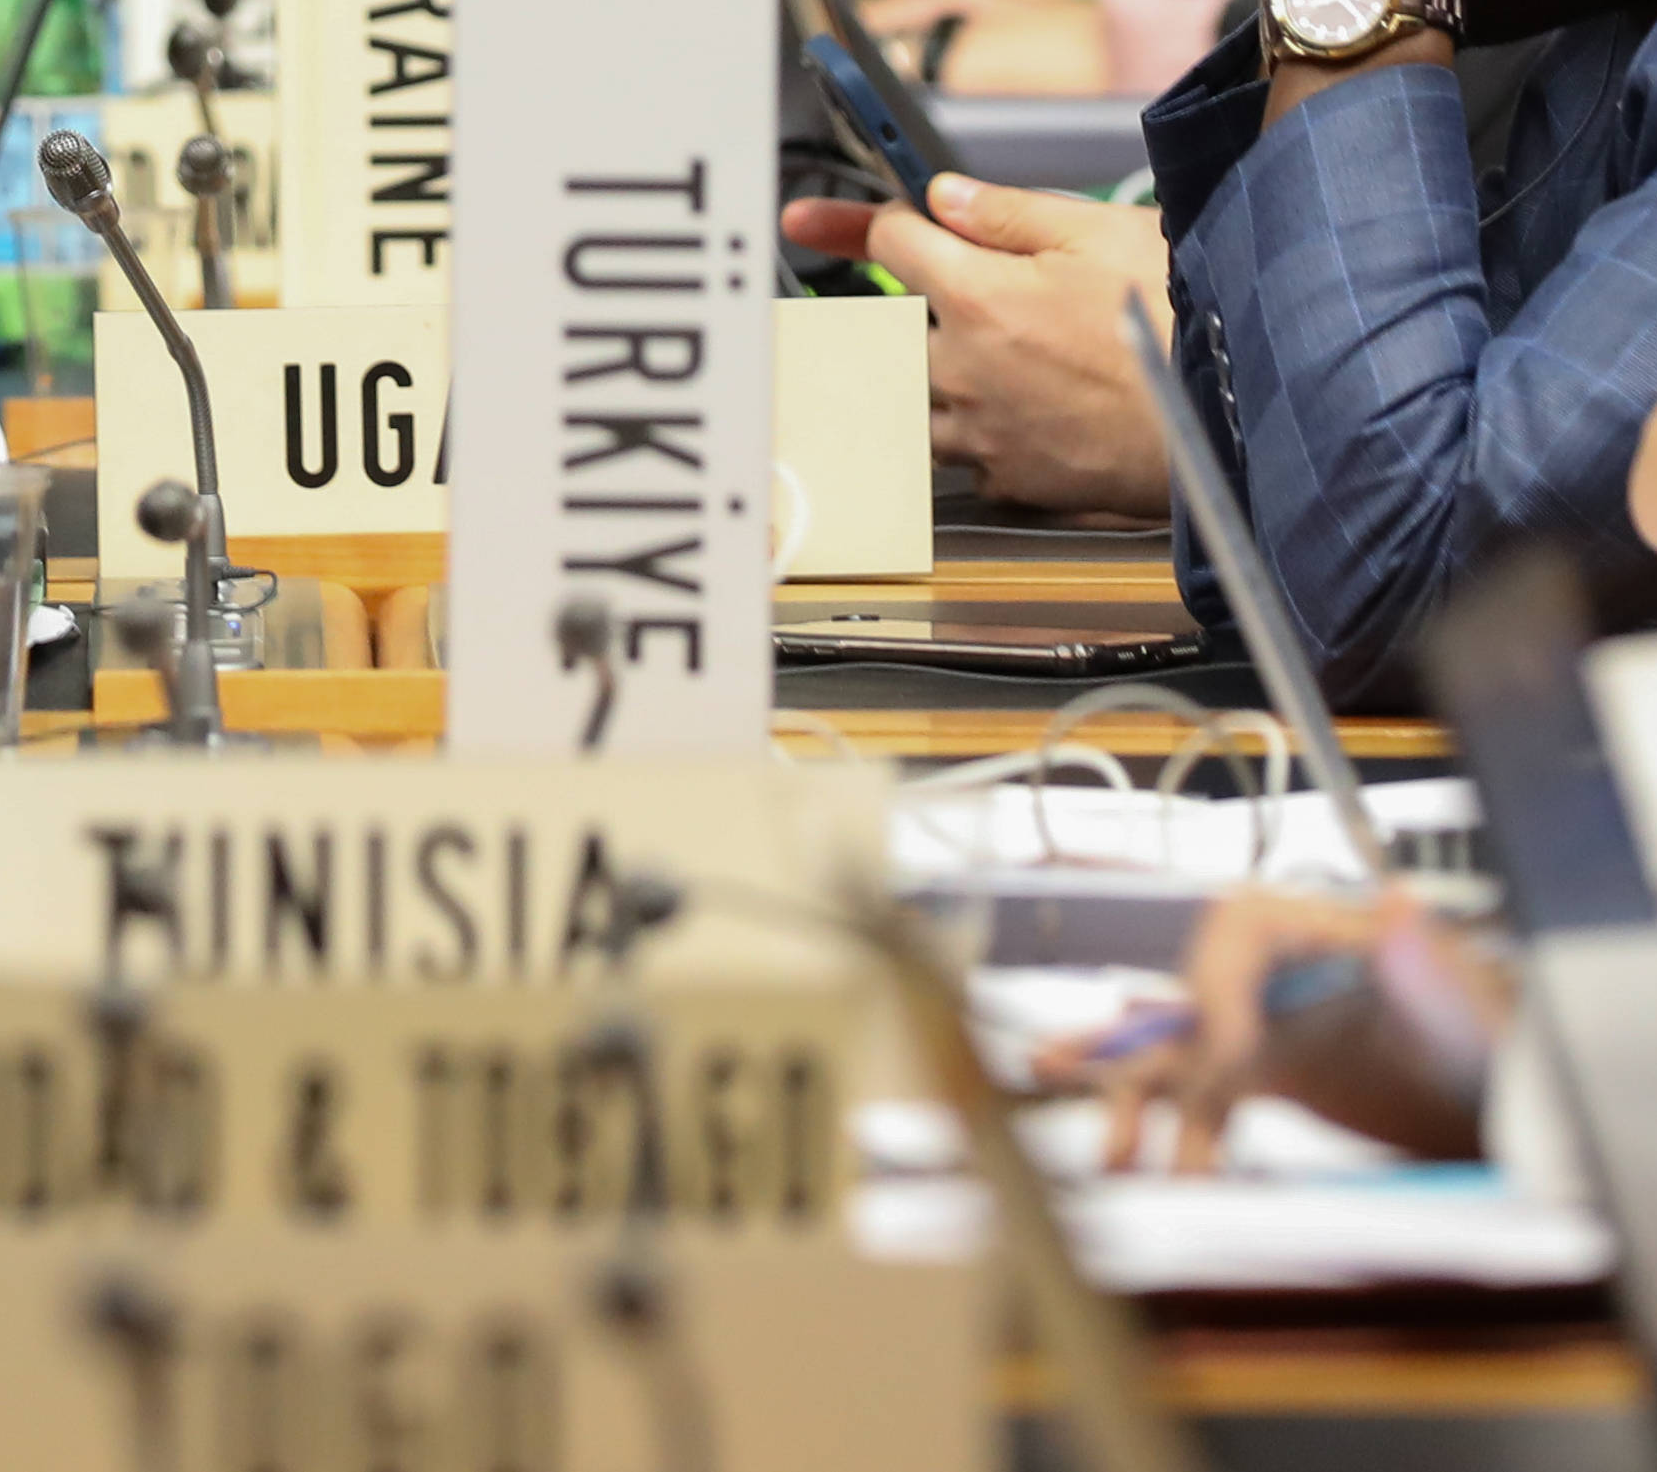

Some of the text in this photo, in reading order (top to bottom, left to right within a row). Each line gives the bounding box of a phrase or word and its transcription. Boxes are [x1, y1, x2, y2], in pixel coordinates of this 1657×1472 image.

[284, 360, 452, 490] UG
[560, 158, 745, 675] TÜRKİYE
[83, 821, 632, 979] TUNISIA
[272, 1045, 359, 1221] &
